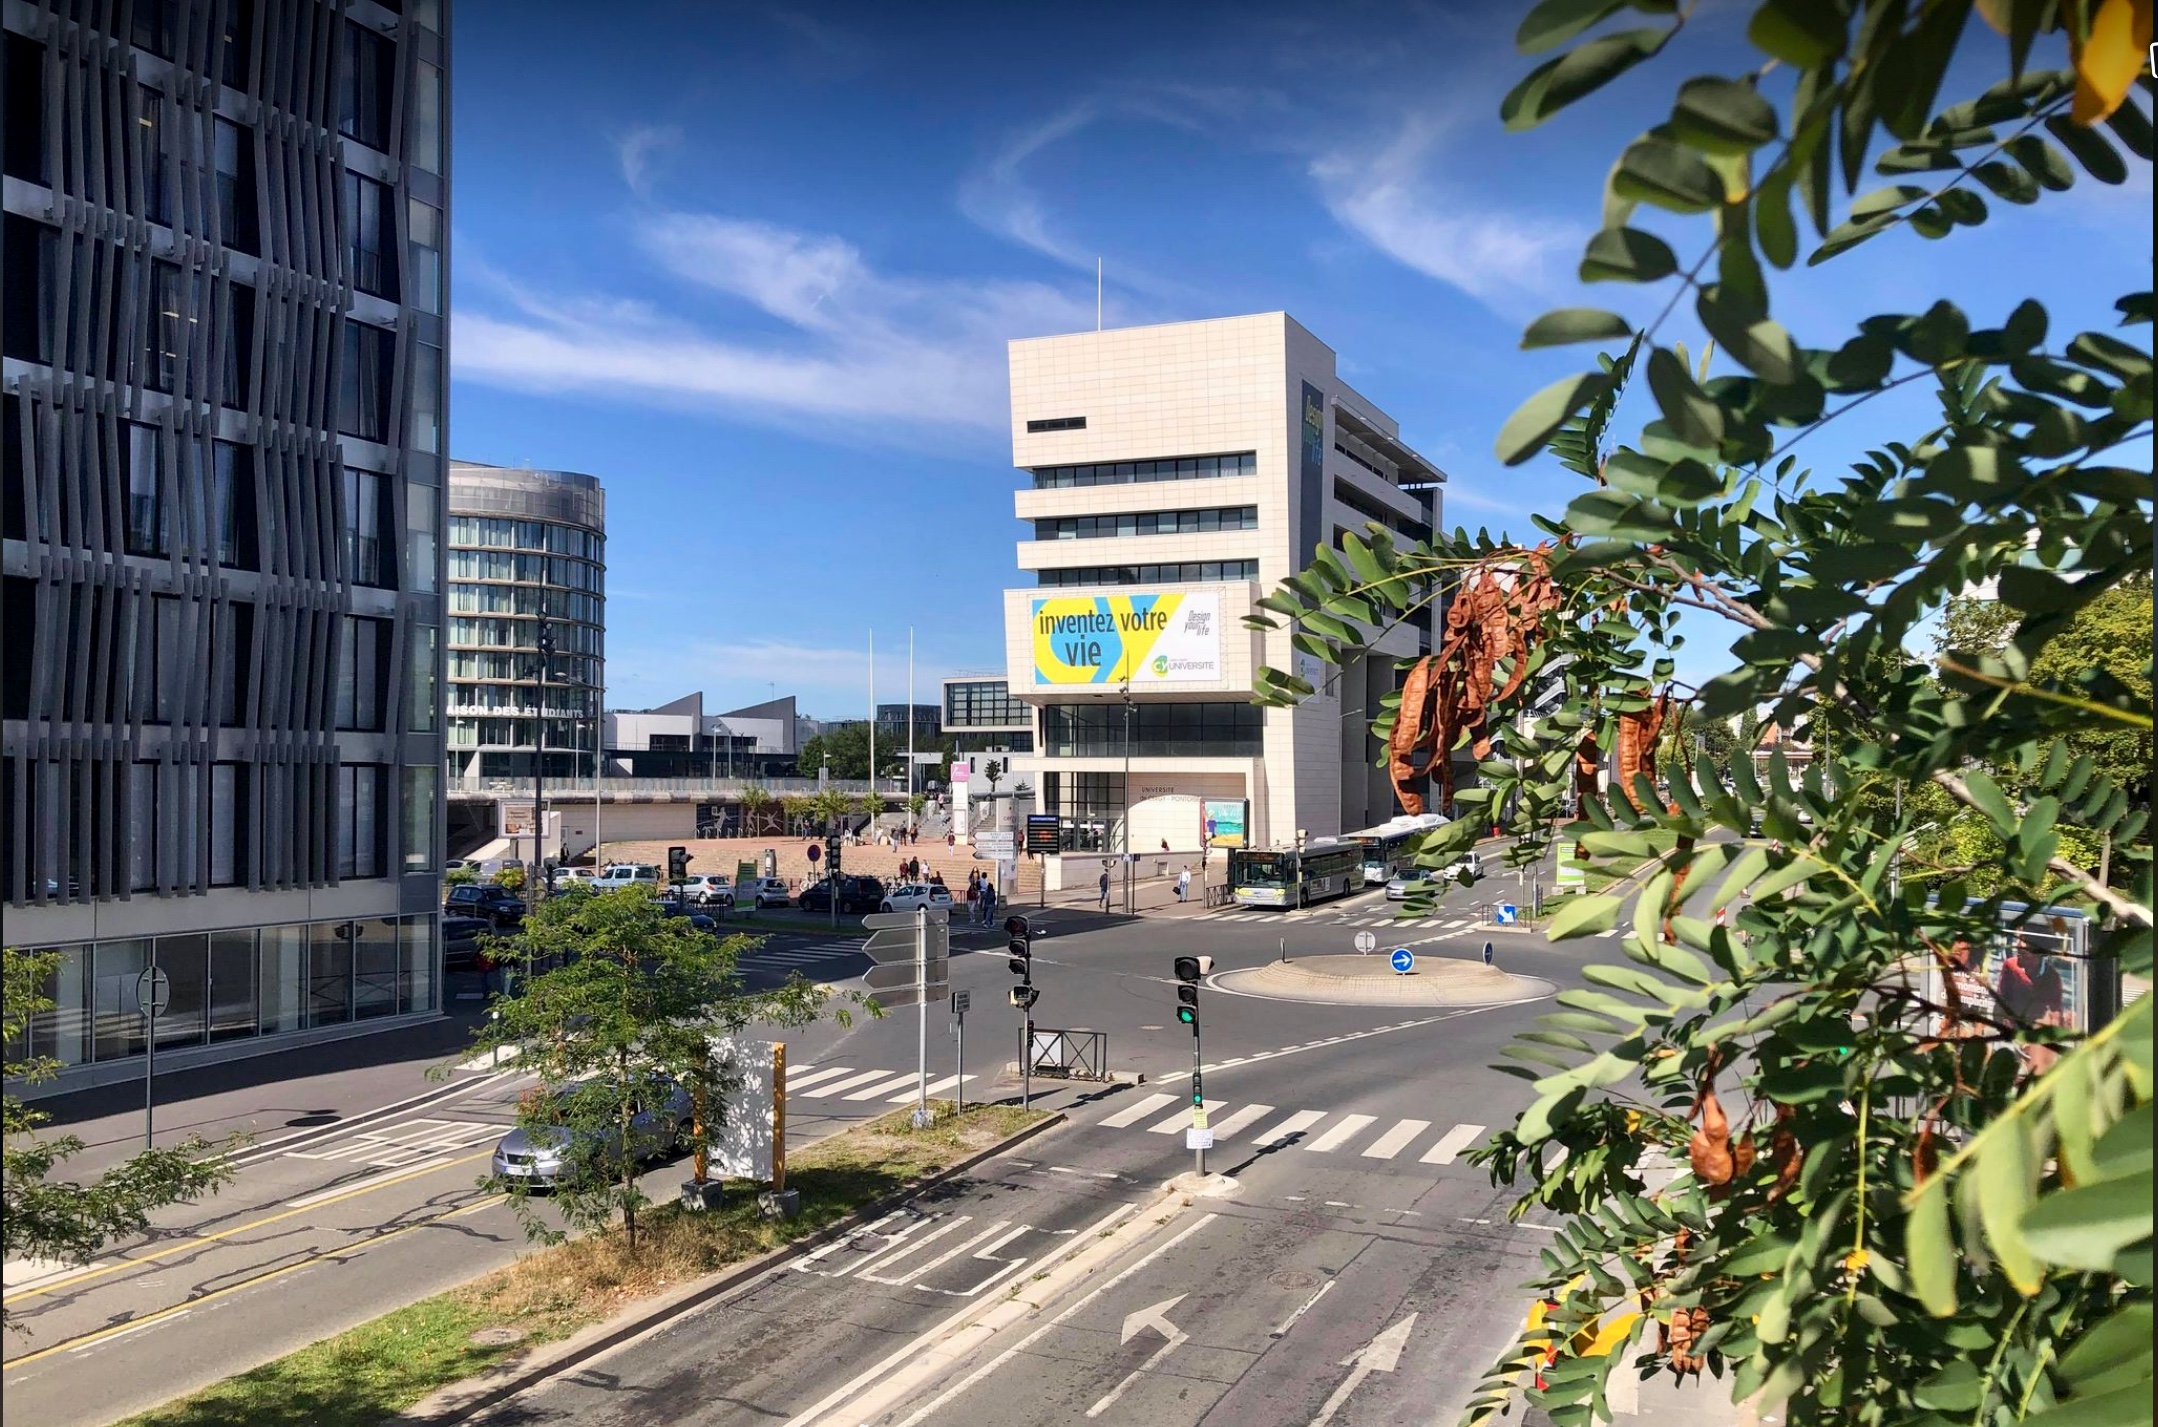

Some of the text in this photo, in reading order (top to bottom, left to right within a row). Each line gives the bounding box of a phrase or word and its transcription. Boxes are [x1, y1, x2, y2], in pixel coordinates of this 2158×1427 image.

[1039, 607, 1168, 634] inventez votre
[1188, 610, 1211, 624] Design
[1196, 624, 1210, 636] life
[1065, 634, 1102, 666] vie
